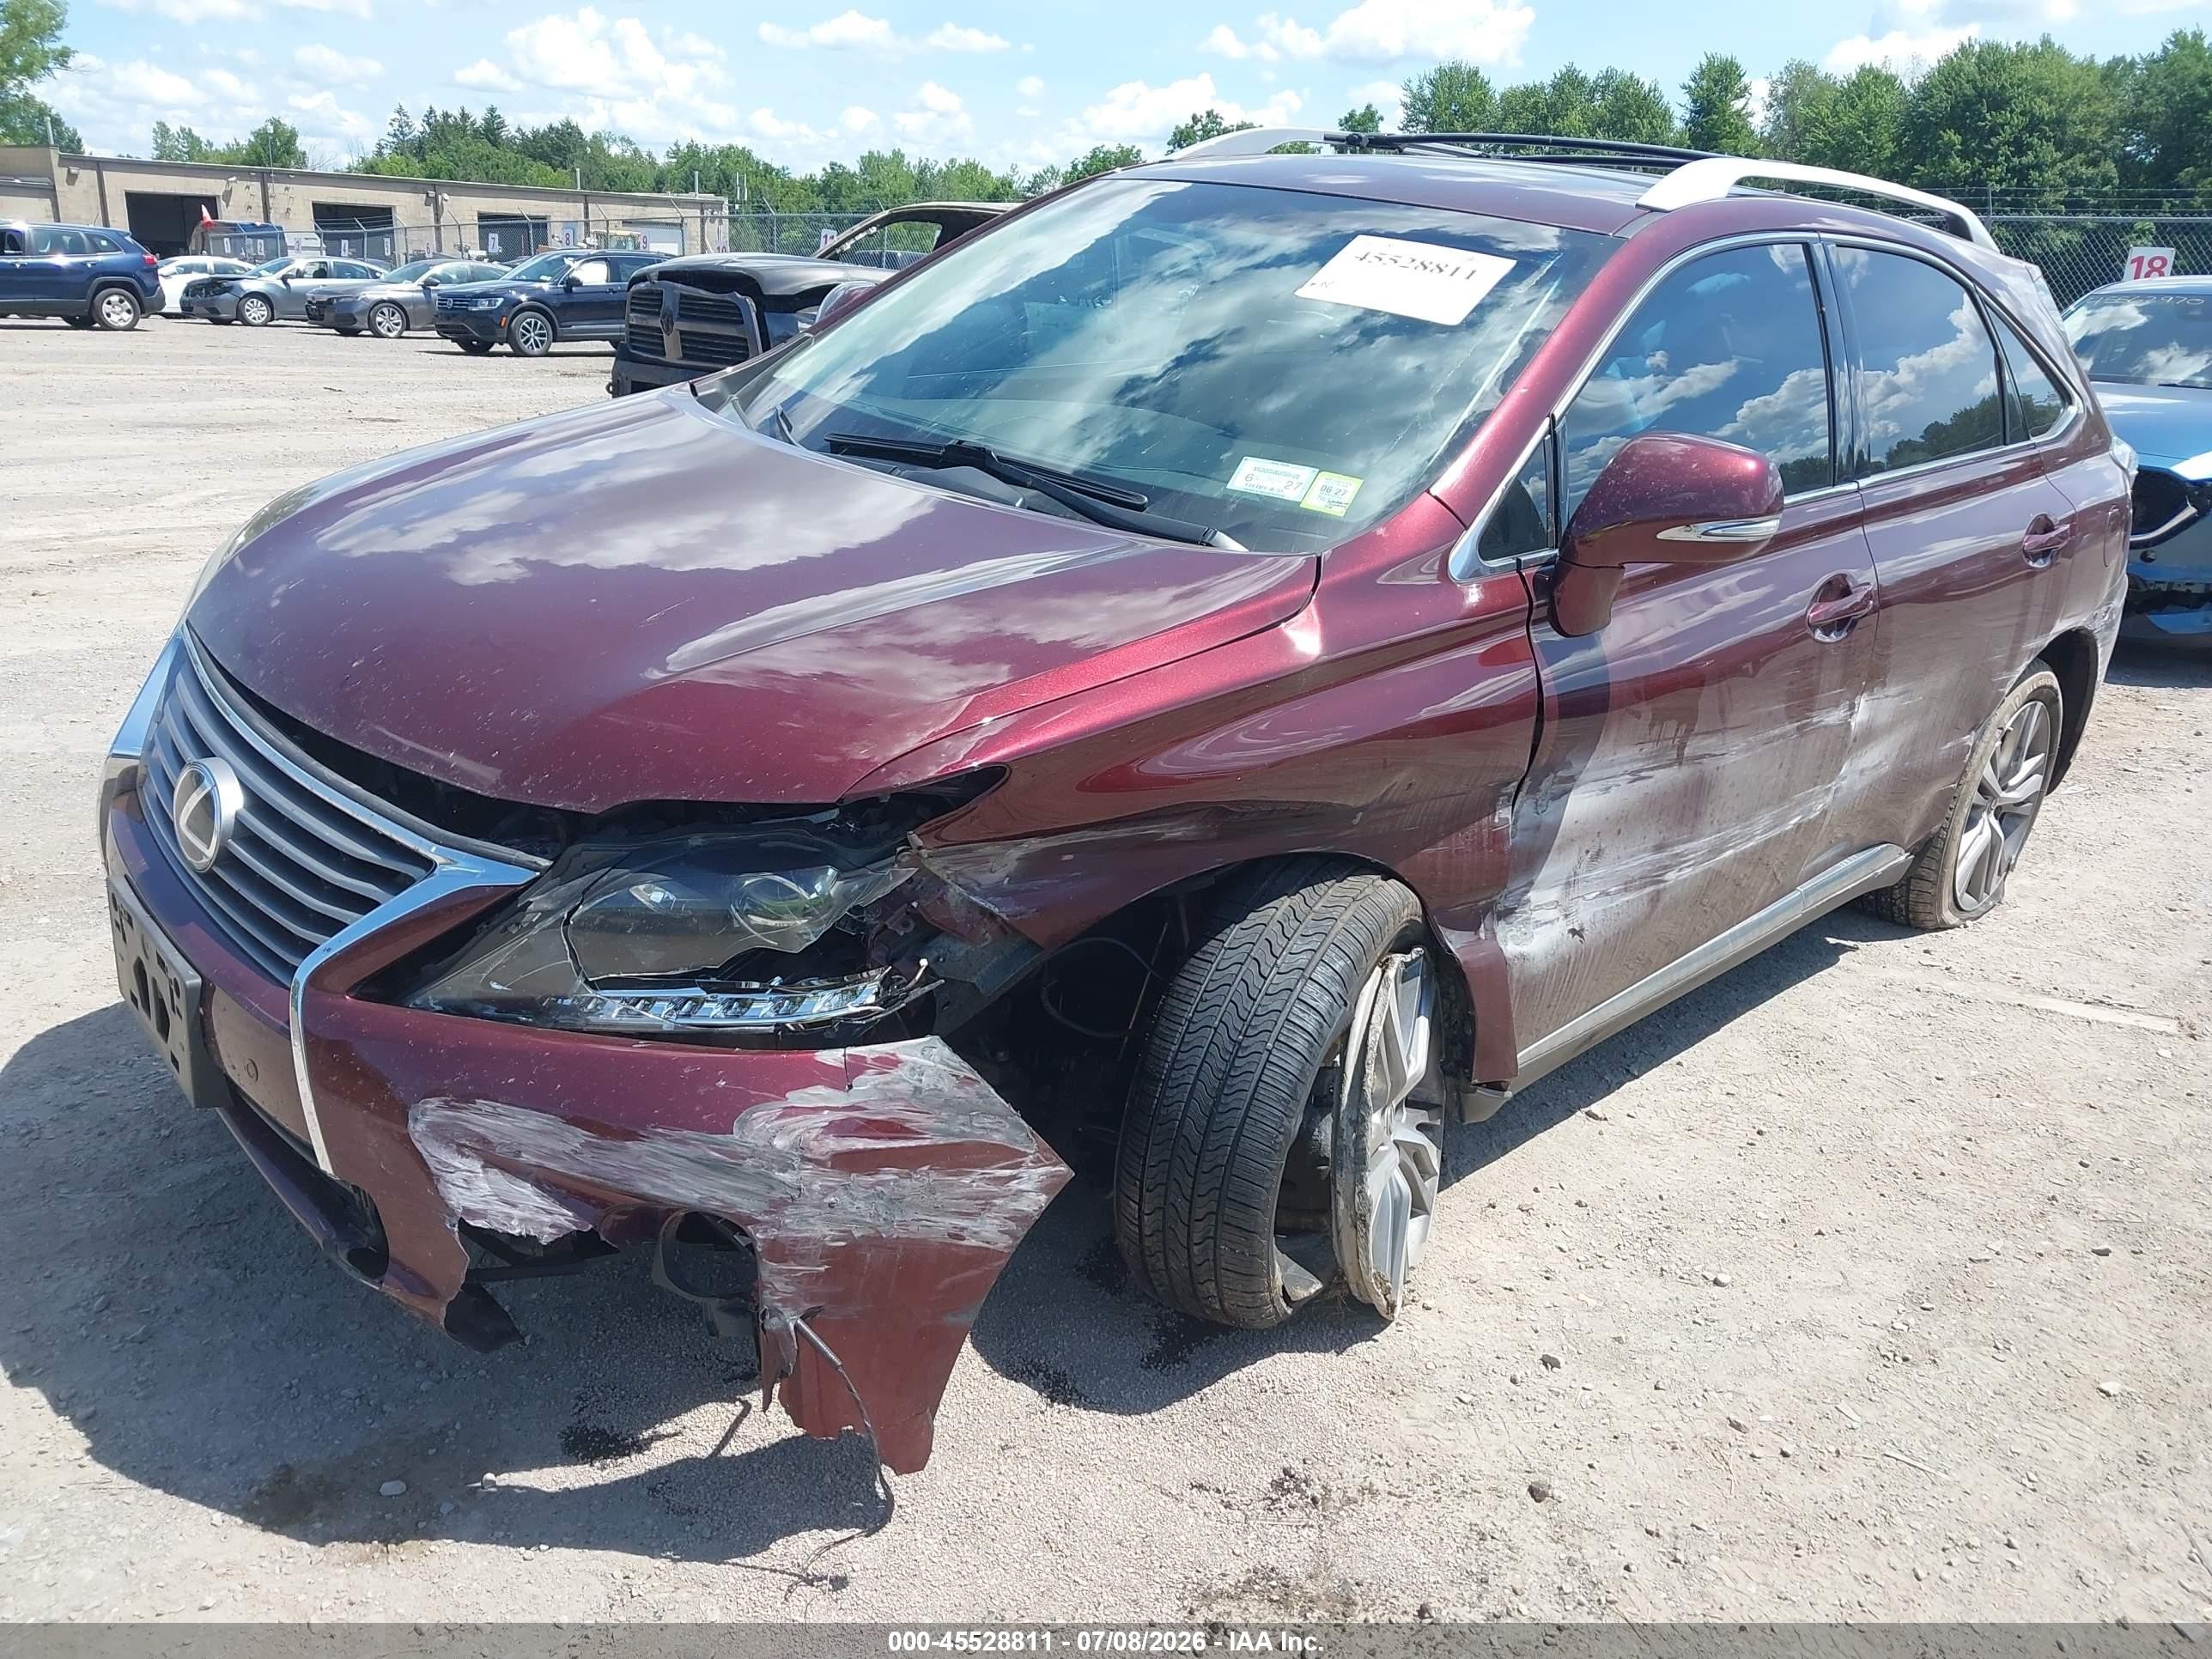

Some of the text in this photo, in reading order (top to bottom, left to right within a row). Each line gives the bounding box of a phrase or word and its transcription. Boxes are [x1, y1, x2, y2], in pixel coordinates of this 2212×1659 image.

[1354, 252, 1477, 280] 45528811
[2130, 255, 2168, 280] 18
[1244, 473, 1255, 482] 6
[1284, 480, 1304, 491] 27
